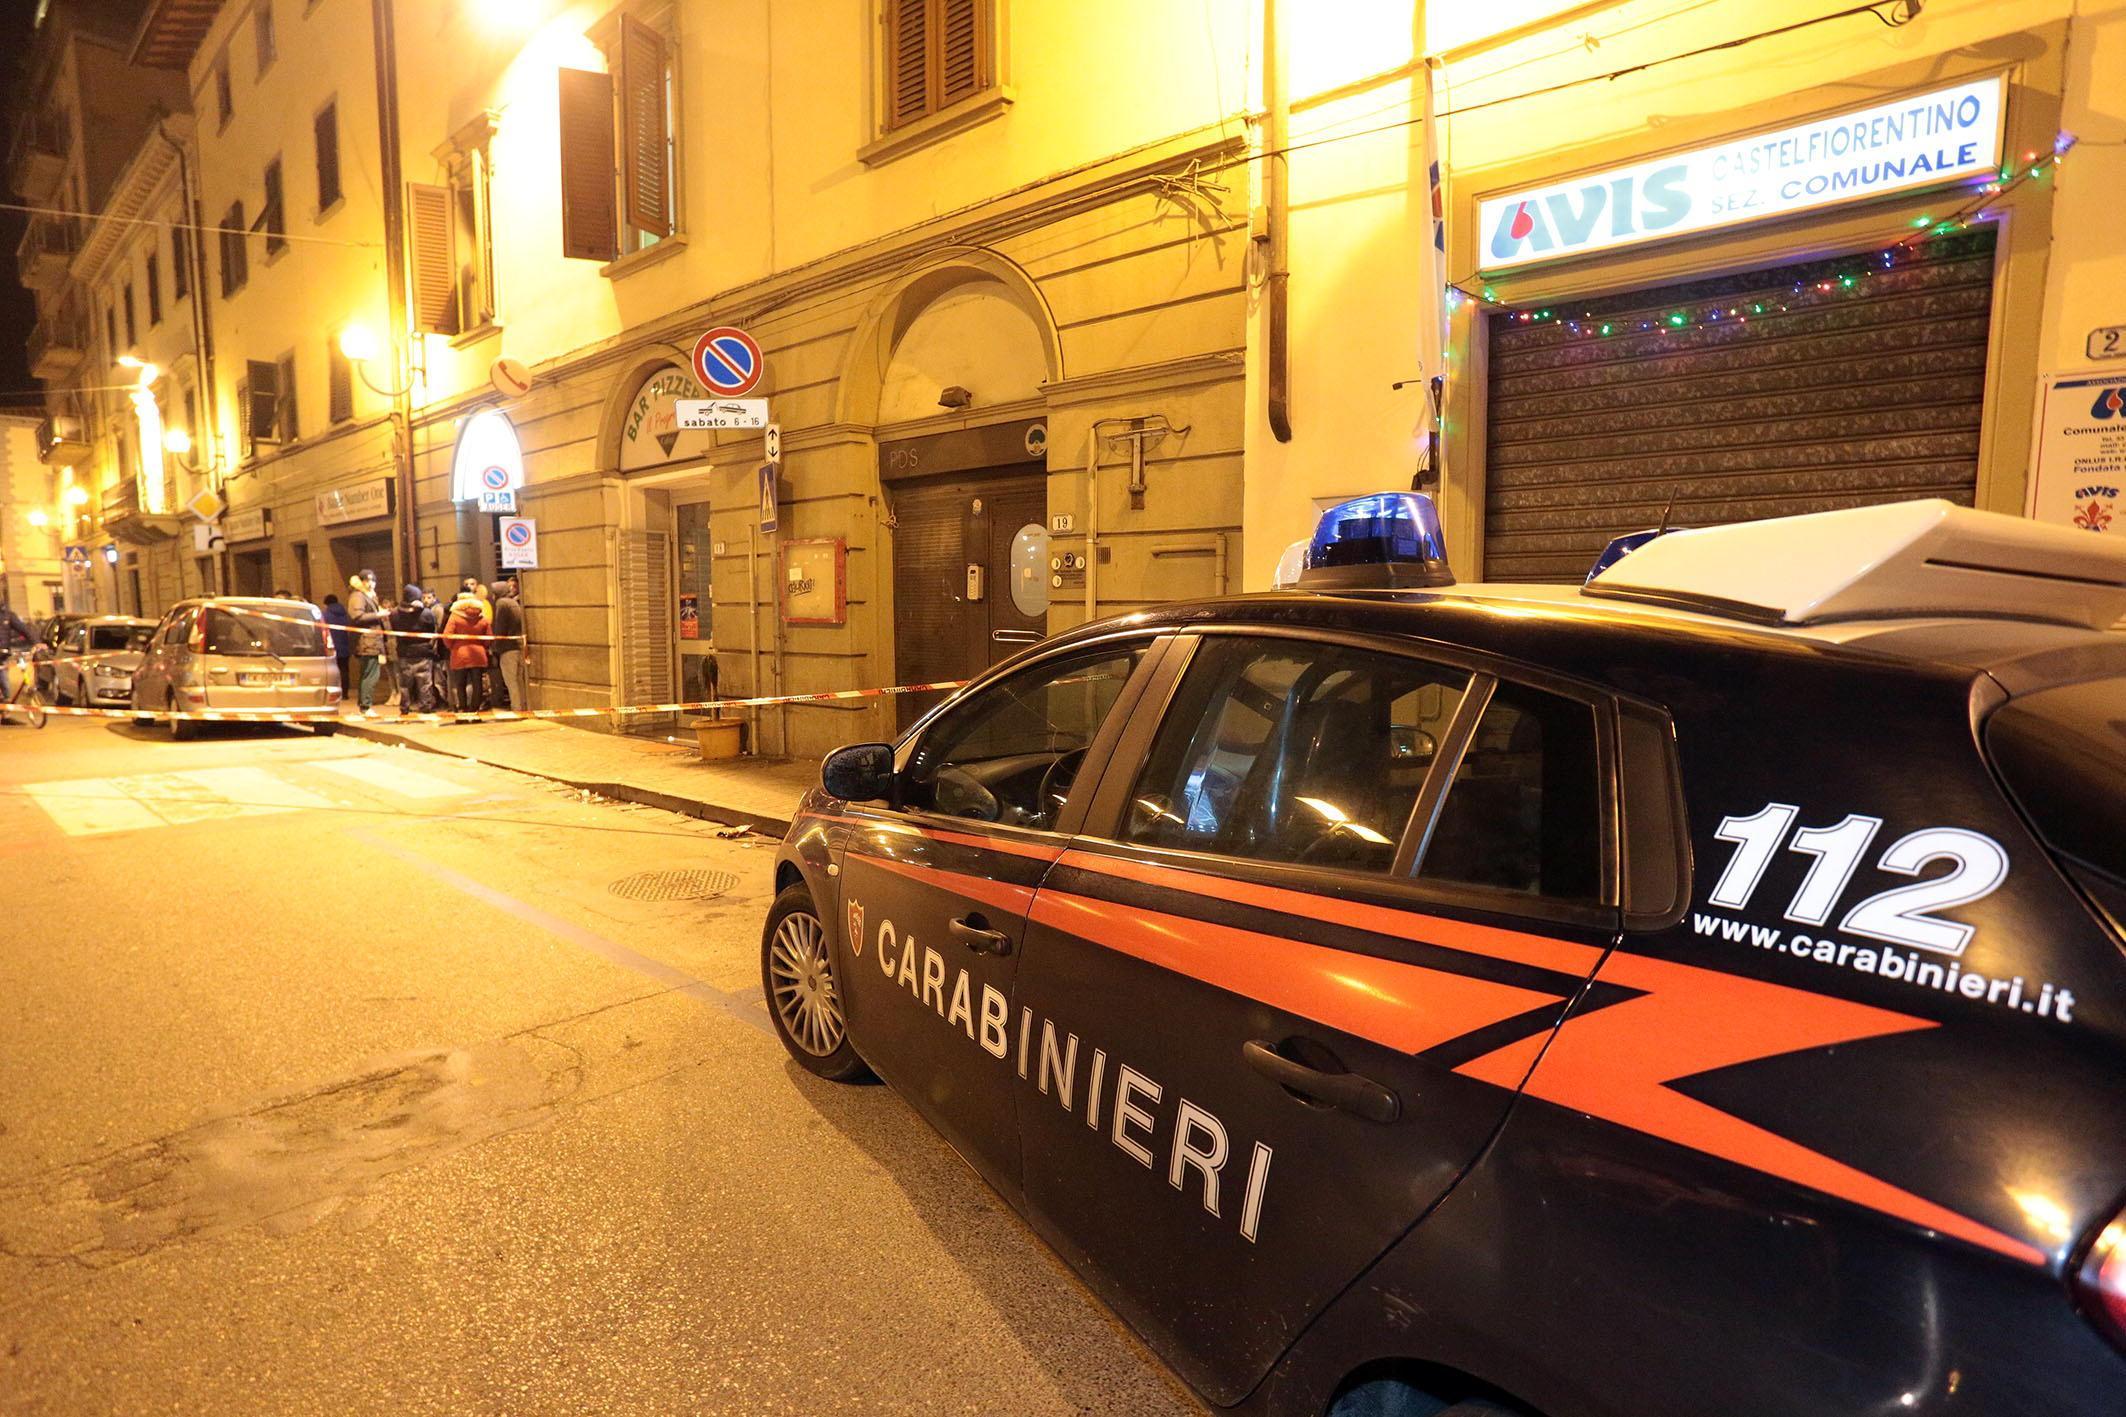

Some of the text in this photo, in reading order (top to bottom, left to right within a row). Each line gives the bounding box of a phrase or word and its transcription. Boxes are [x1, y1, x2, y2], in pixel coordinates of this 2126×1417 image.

[1711, 142, 1978, 214] SEZ. COMUNALE
[1713, 95, 1981, 182] CASTELFIORENTINO
[1490, 164, 1693, 260] AVIS
[627, 396, 650, 443] BAR
[684, 417, 726, 427] sabato
[734, 418, 740, 427] 6
[751, 417, 760, 426] 16
[2073, 465, 2120, 473] Fondata
[1057, 517, 1068, 528] 19
[1707, 802, 2010, 957] 112
[1693, 912, 2077, 1023] www.carabinieri.it
[877, 918, 1273, 1245] CARABINIERI
